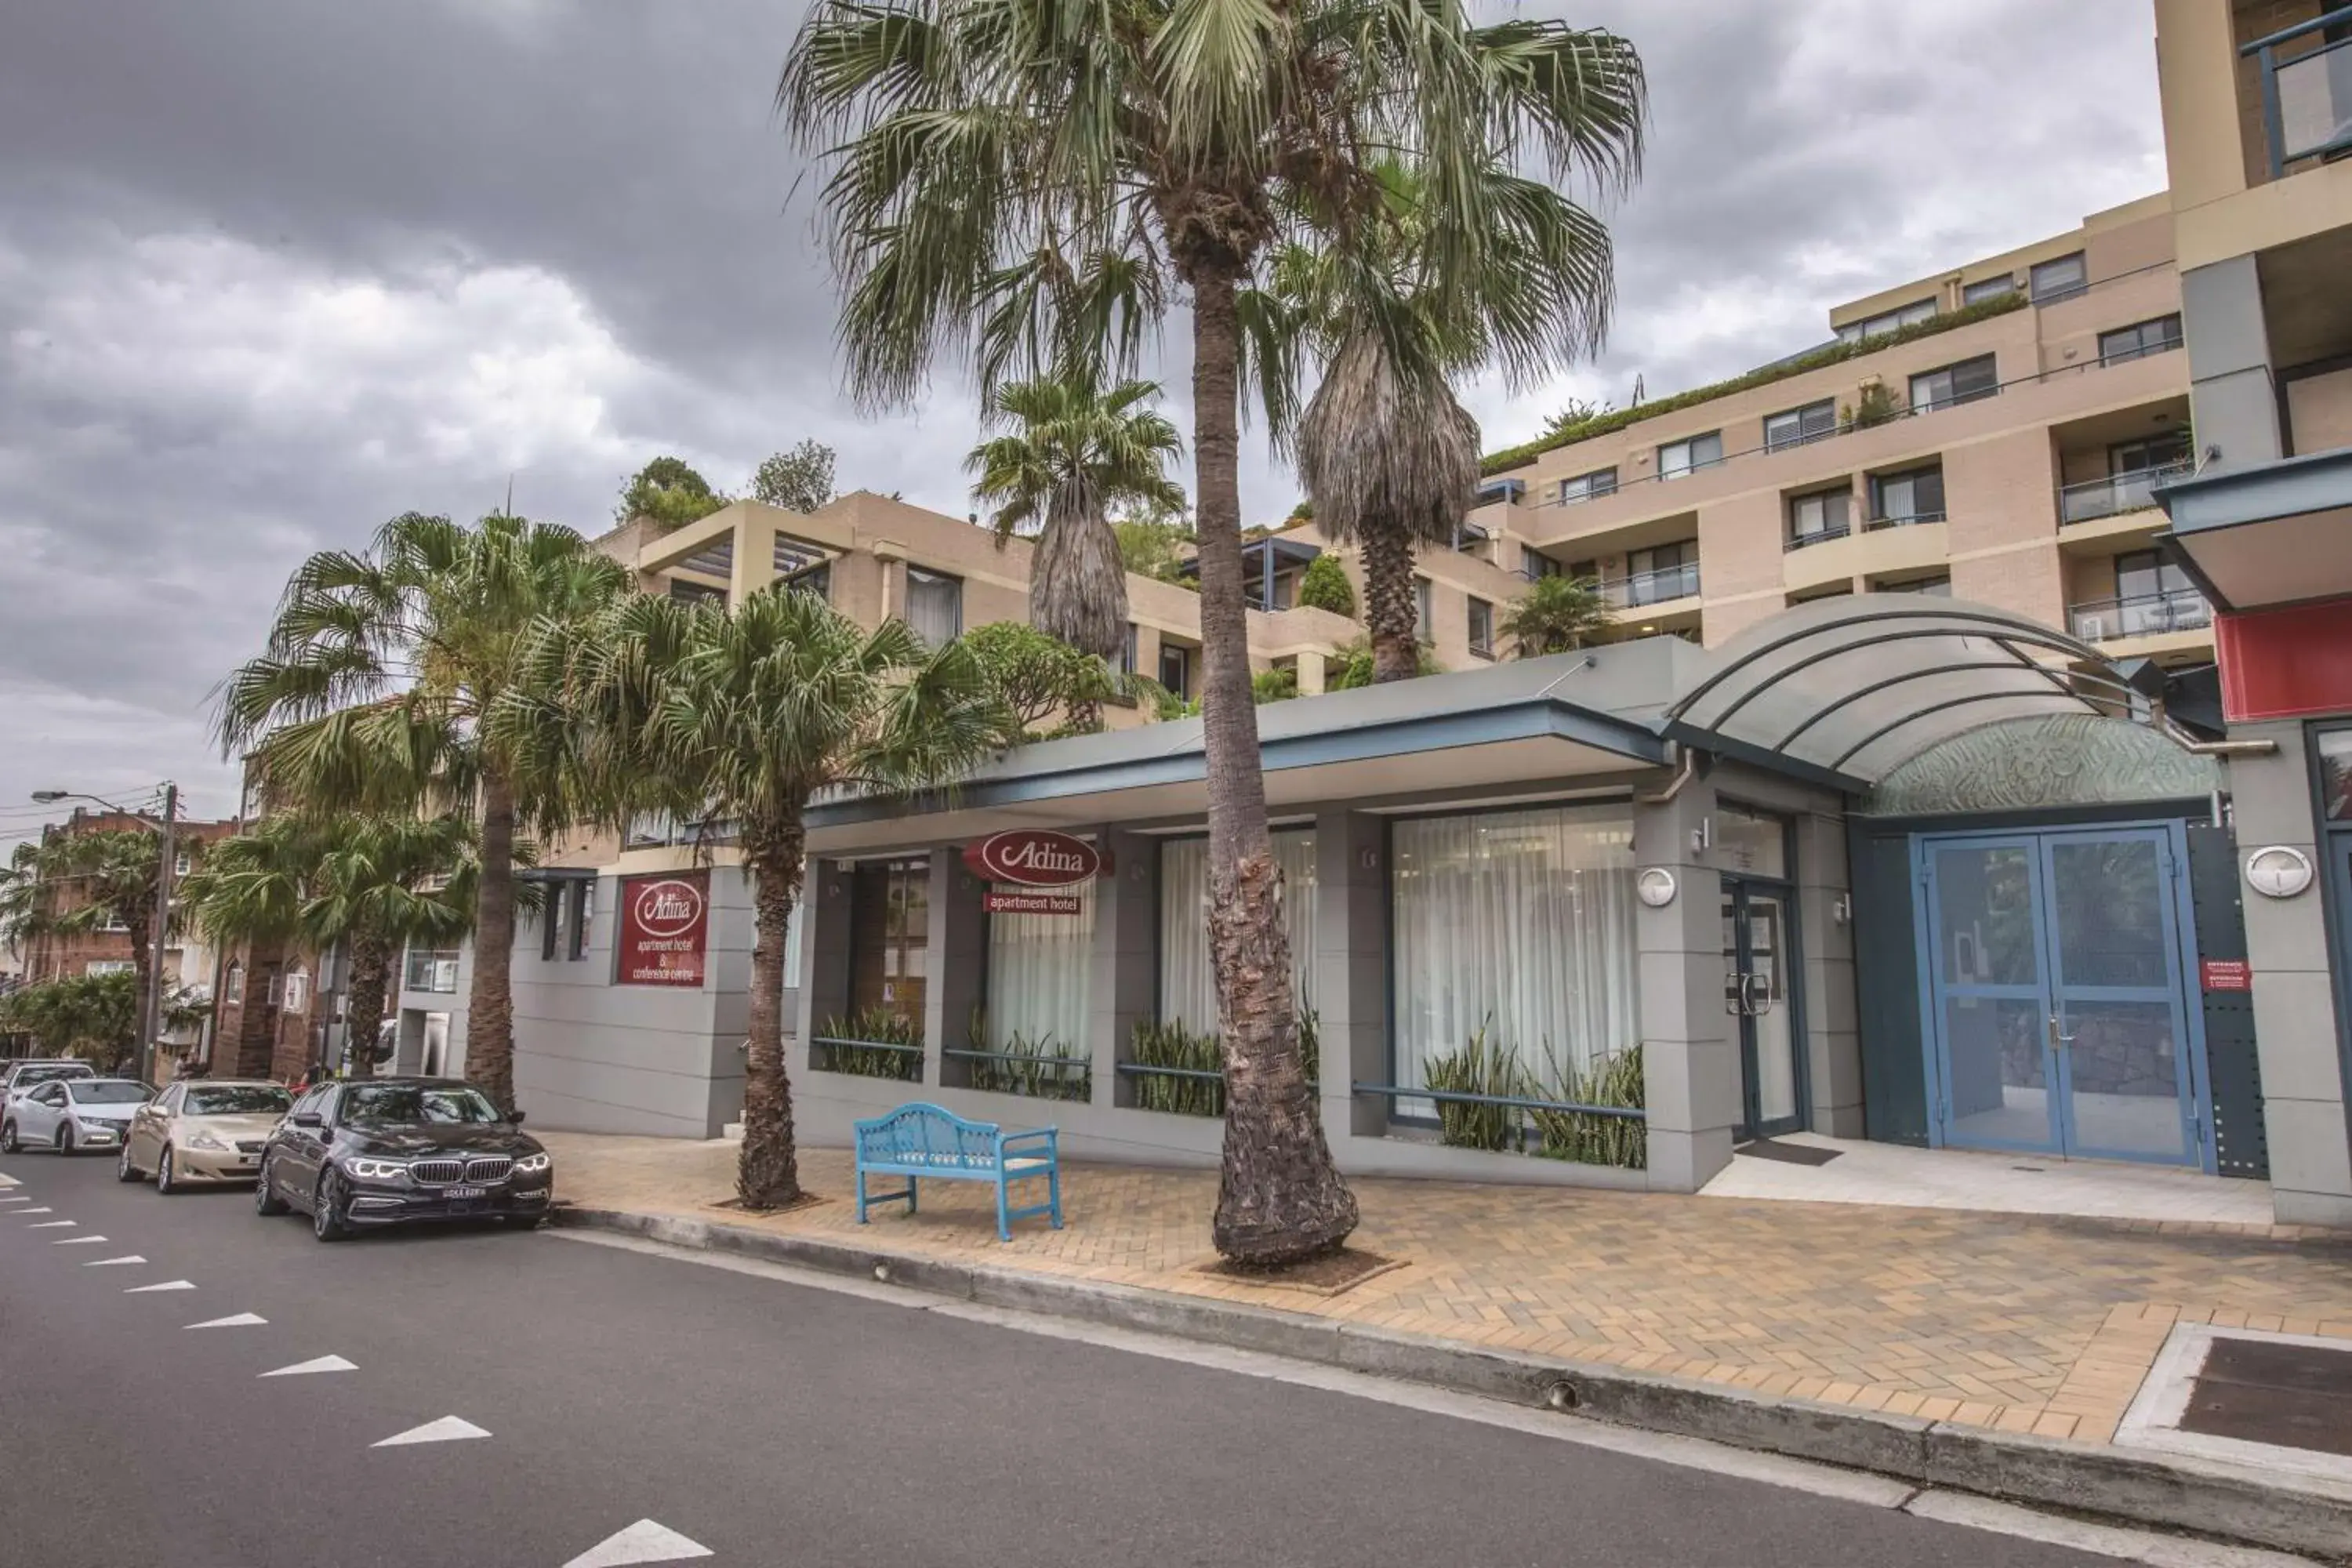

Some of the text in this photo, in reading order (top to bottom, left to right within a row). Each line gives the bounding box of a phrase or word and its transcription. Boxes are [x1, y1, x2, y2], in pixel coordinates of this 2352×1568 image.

[1001, 840, 1084, 872] Adina
[644, 893, 691, 920] Adina
[990, 896, 1077, 911] apartment hotel
[637, 937, 694, 954] apartment hotel
[633, 966, 670, 979] conference
